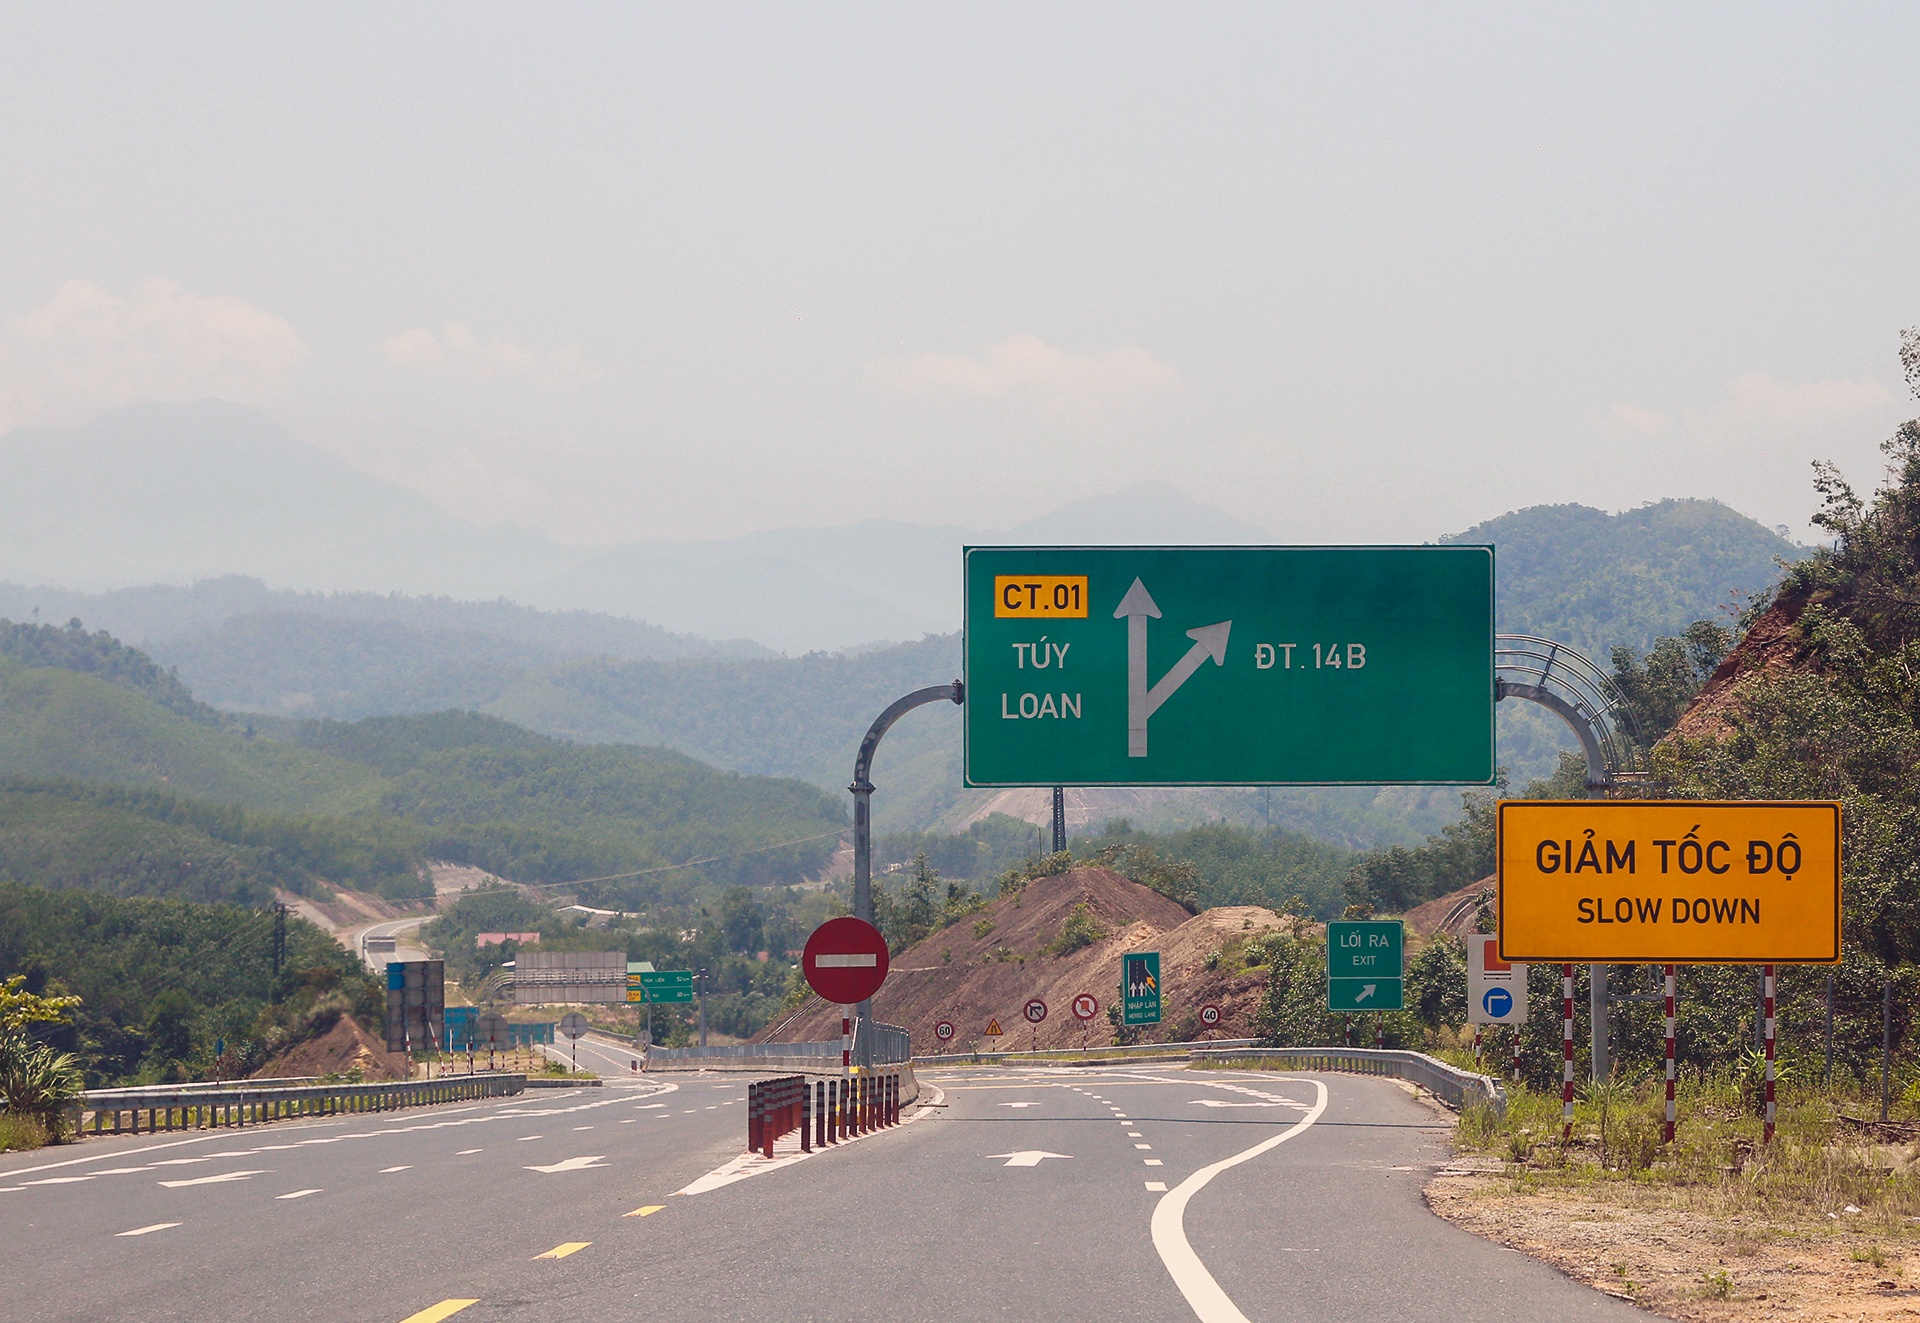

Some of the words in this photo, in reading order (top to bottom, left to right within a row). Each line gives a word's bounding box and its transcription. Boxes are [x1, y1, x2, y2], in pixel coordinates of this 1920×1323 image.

[1003, 584, 1080, 610] CT.01
[1012, 635, 1071, 669] TÚY
[1254, 643, 1366, 669] ĐT.14B
[1002, 692, 1081, 719] LOAN
[1536, 828, 1636, 874] GIẢM
[1652, 824, 1731, 874] TỐC
[1746, 832, 1802, 881] ĐỘ
[1576, 897, 1663, 924] SLOW
[1672, 897, 1760, 924] DOWN
[1340, 929, 1361, 948] LỐI
[1369, 934, 1390, 948] RA
[1352, 955, 1377, 966] EXIT
[1204, 1010, 1216, 1020] 40
[939, 1026, 951, 1036] 60
